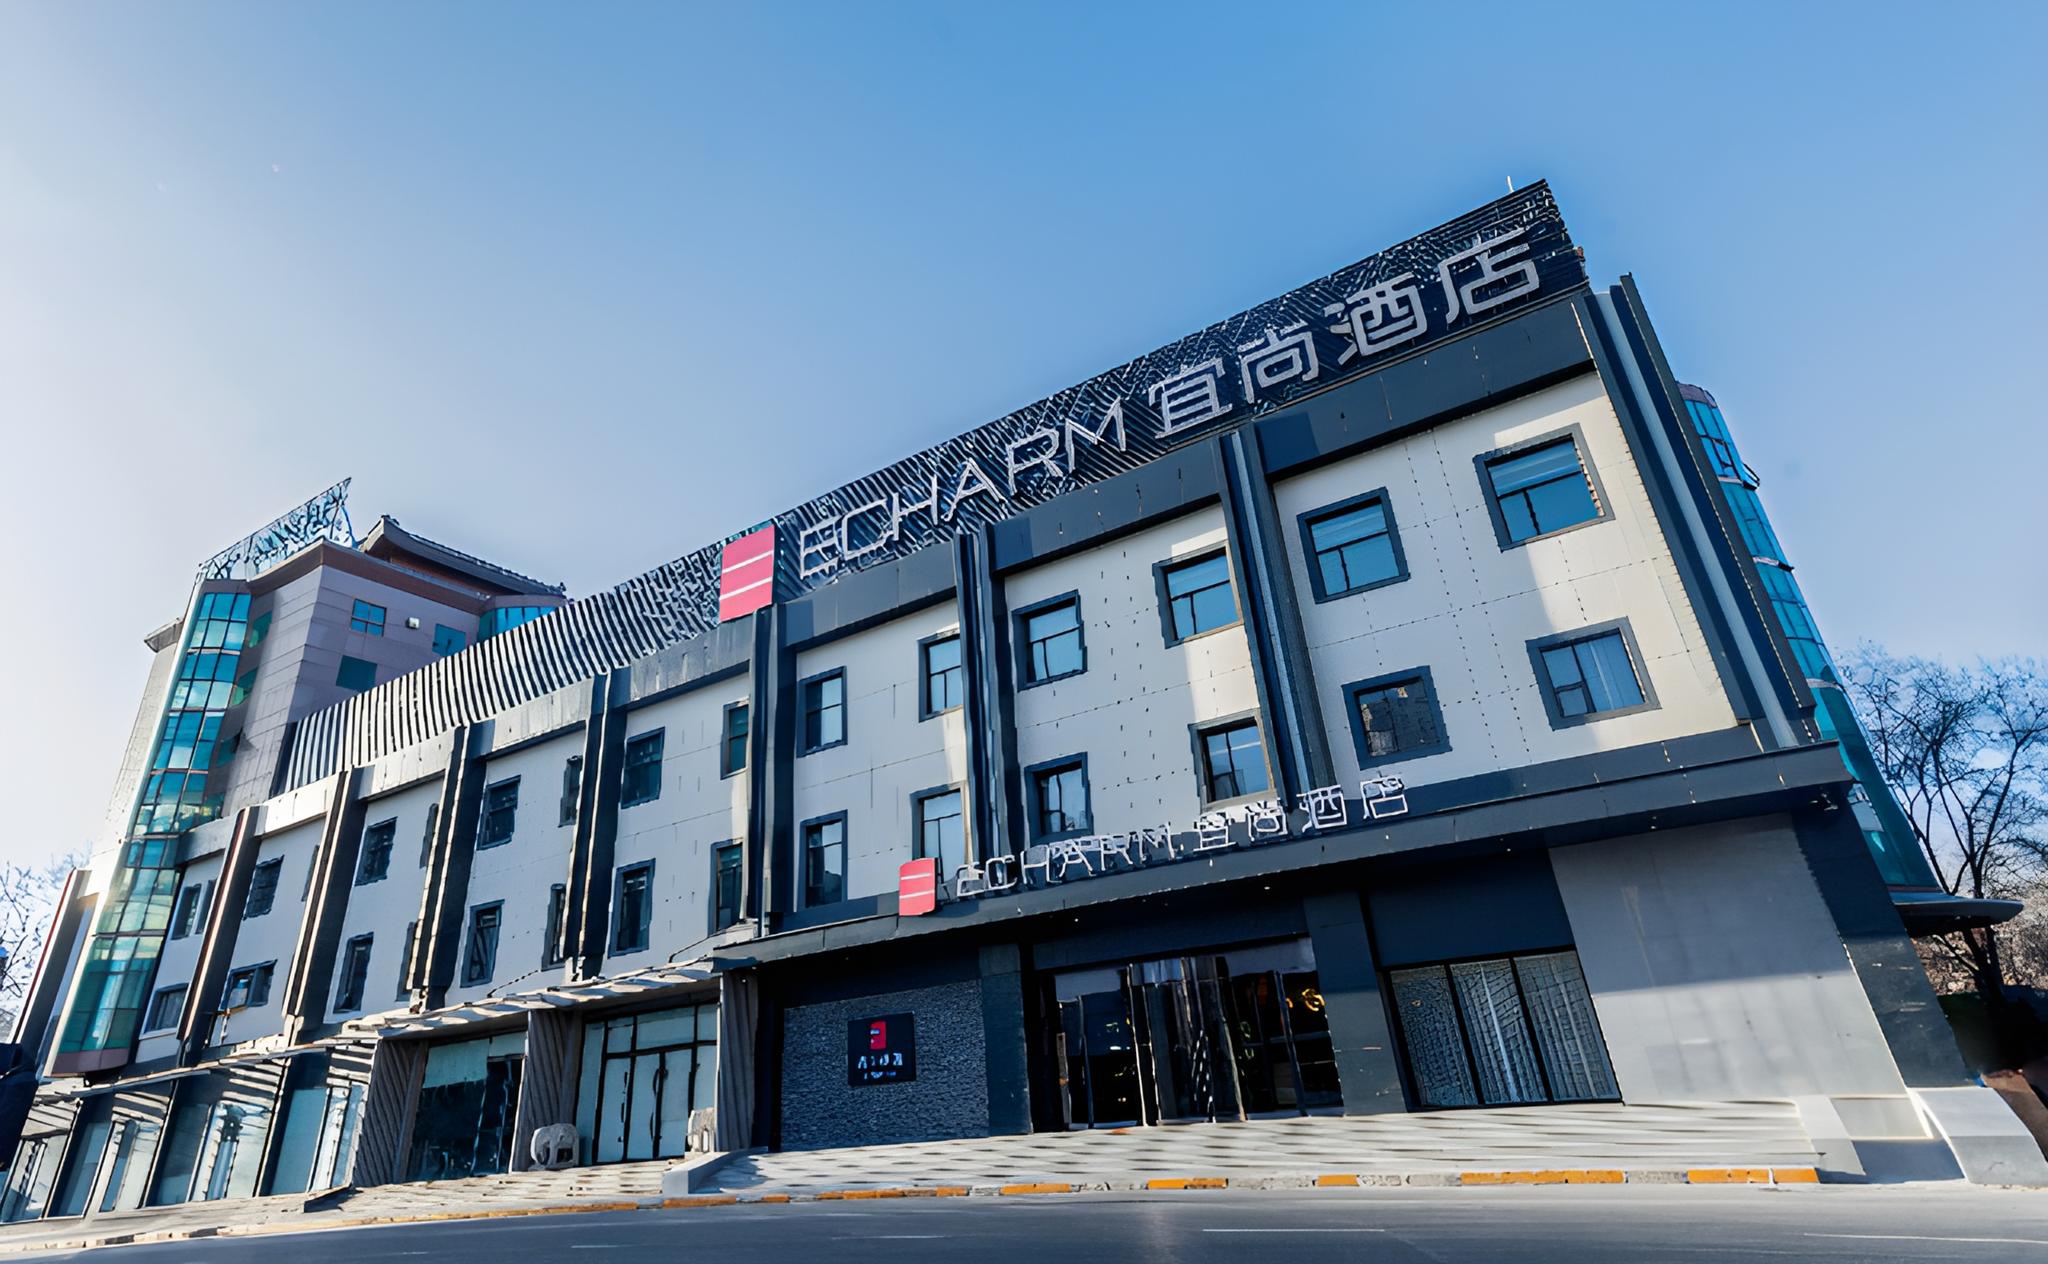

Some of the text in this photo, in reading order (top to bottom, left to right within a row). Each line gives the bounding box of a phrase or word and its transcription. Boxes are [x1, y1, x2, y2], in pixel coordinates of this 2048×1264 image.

[799, 227, 1540, 580] ECHARM 宜尚酒店
